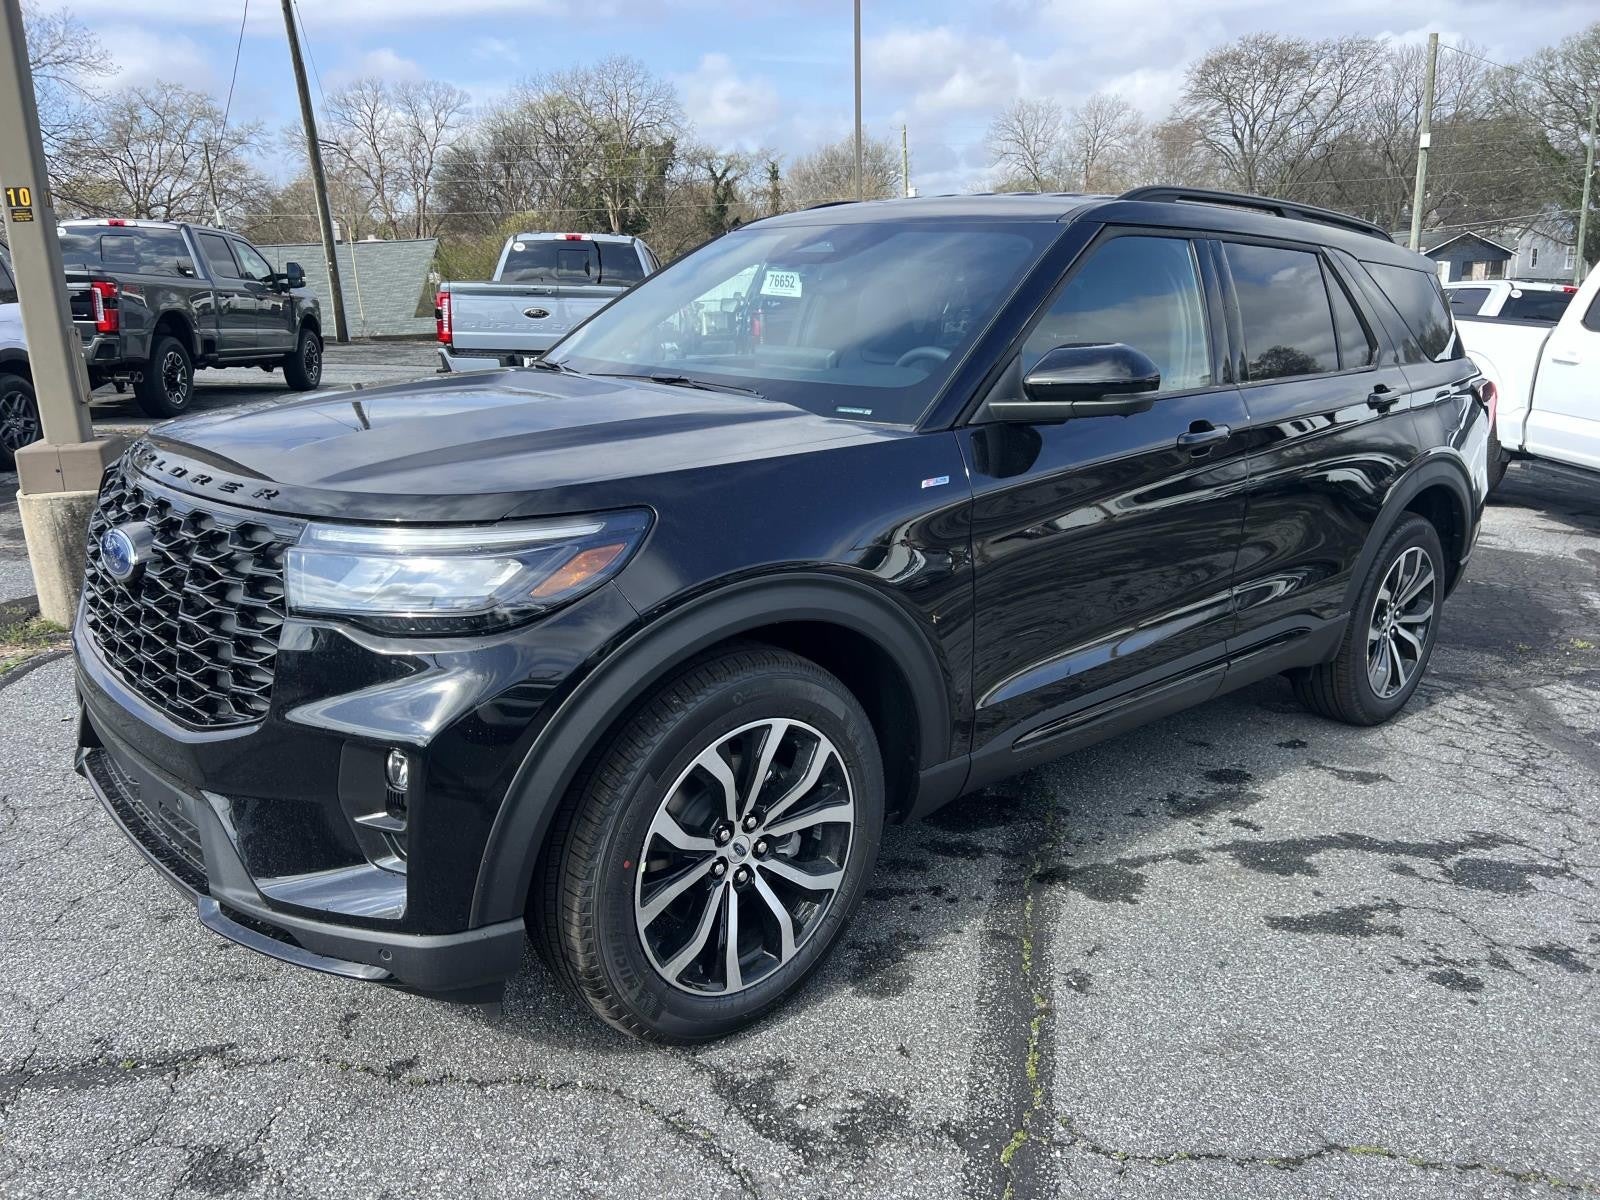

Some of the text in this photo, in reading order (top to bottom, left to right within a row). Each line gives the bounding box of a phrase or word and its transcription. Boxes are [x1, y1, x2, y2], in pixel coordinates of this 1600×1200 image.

[7, 187, 30, 207] 10
[769, 274, 795, 289] 76652
[136, 445, 280, 500] PLORER
